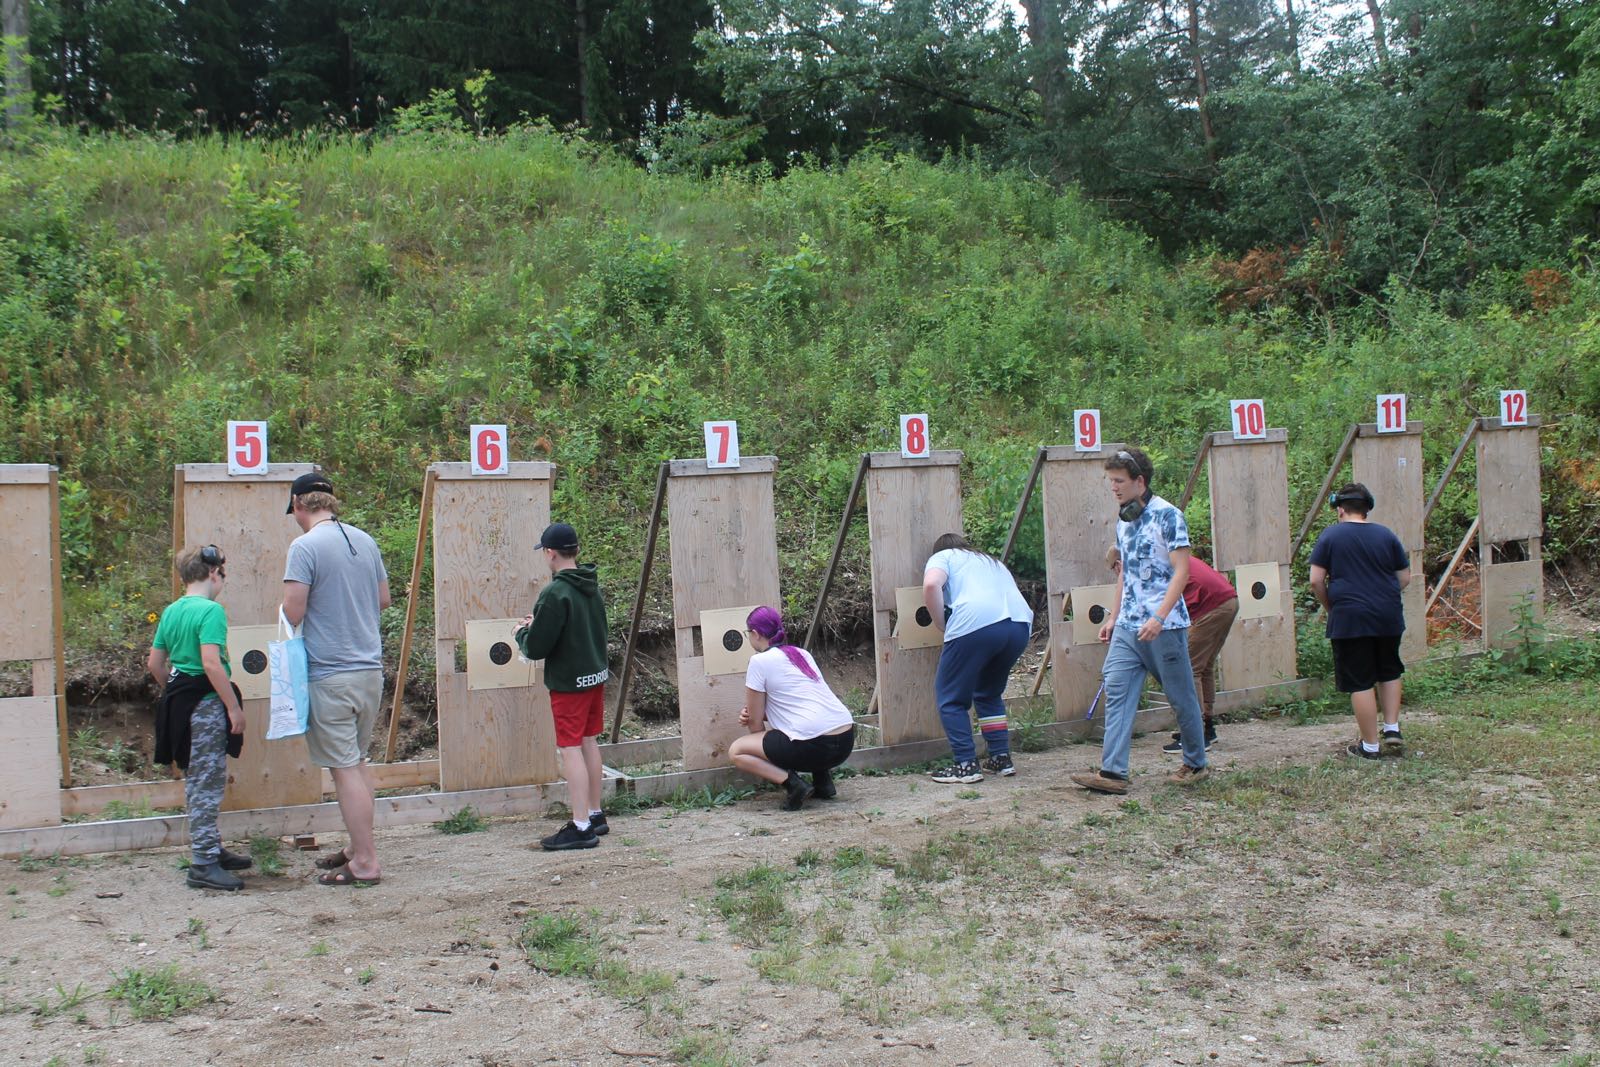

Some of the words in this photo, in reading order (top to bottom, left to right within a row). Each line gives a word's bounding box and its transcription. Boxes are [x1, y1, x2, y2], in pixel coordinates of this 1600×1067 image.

[1234, 403, 1263, 435] 10
[1381, 399, 1401, 427] 11
[1504, 393, 1524, 422] 12
[713, 427, 729, 463] 7
[907, 418, 925, 454] 8
[1080, 413, 1096, 446] 9
[236, 426, 261, 468] 5
[478, 430, 500, 470] 6
